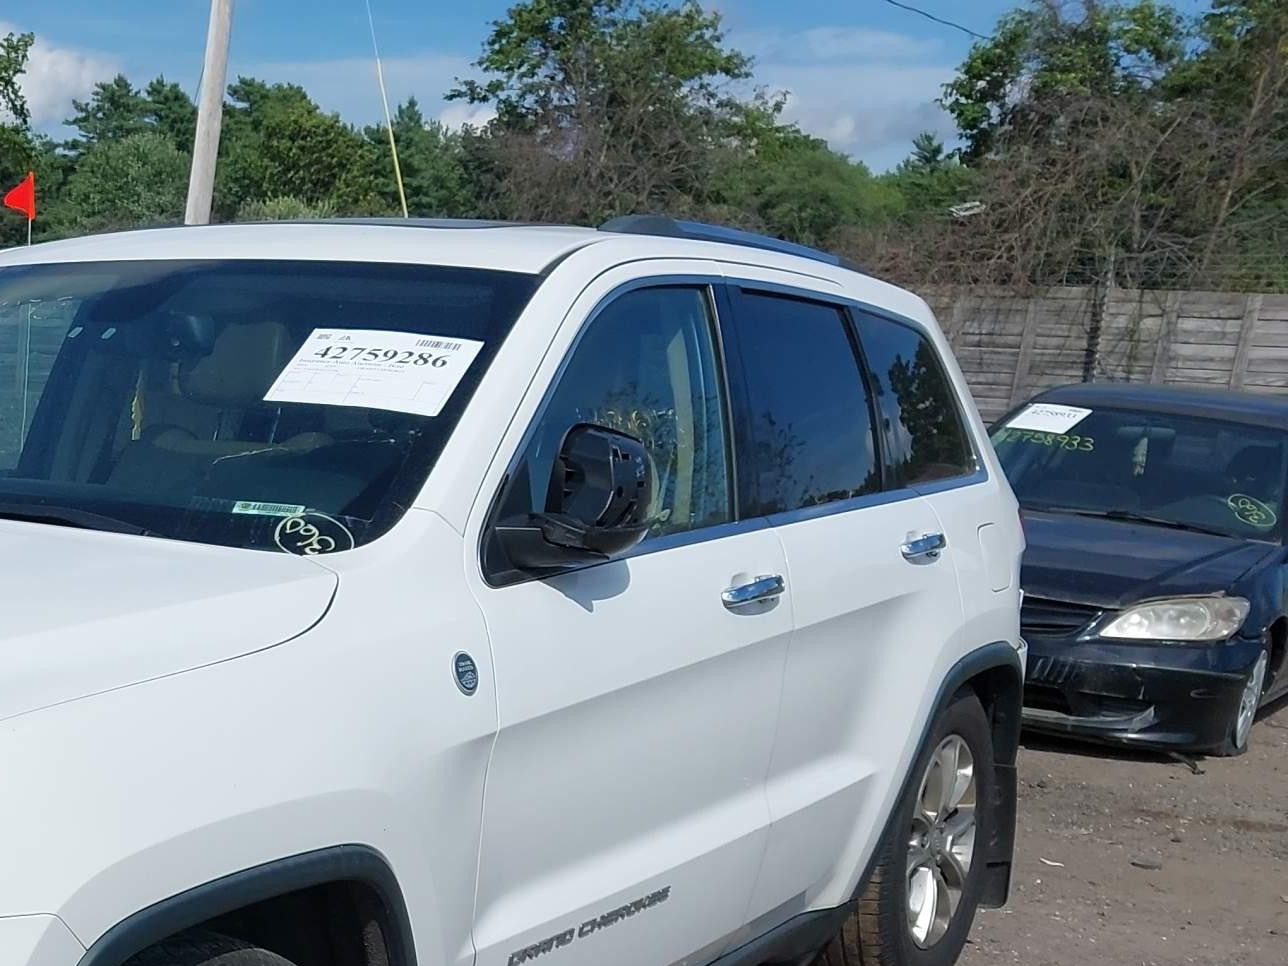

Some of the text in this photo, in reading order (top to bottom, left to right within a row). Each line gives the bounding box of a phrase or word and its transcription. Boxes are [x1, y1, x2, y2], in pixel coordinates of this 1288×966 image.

[313, 345, 452, 369] 42759286
[285, 517, 336, 555] 360
[578, 885, 672, 938] CHEROKEE
